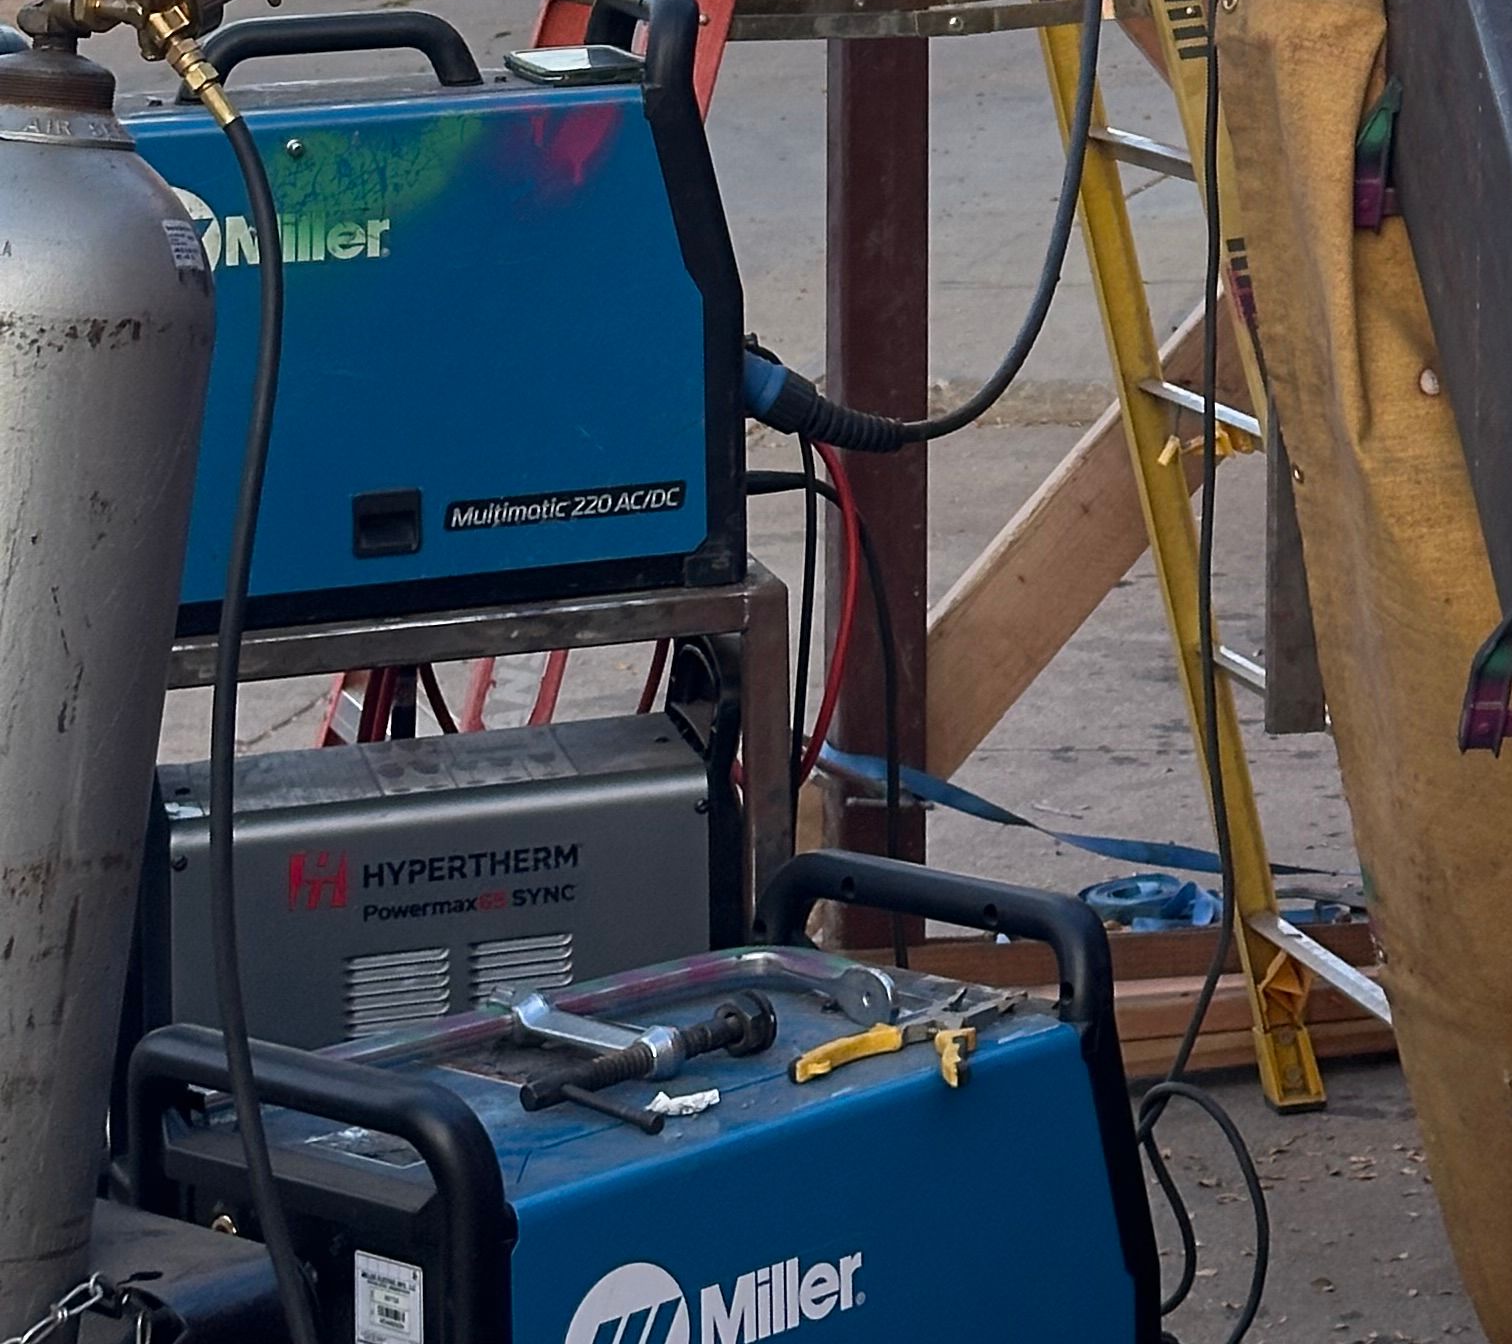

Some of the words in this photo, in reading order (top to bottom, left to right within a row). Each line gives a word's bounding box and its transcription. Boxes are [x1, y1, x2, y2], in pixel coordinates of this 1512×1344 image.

[450, 497, 570, 529] Multimatic
[571, 494, 613, 517] 220
[614, 487, 681, 512] AC/DC
[362, 843, 579, 888] HYPERTHERM
[512, 884, 577, 907] SYNC
[700, 1251, 862, 1344] Miller
